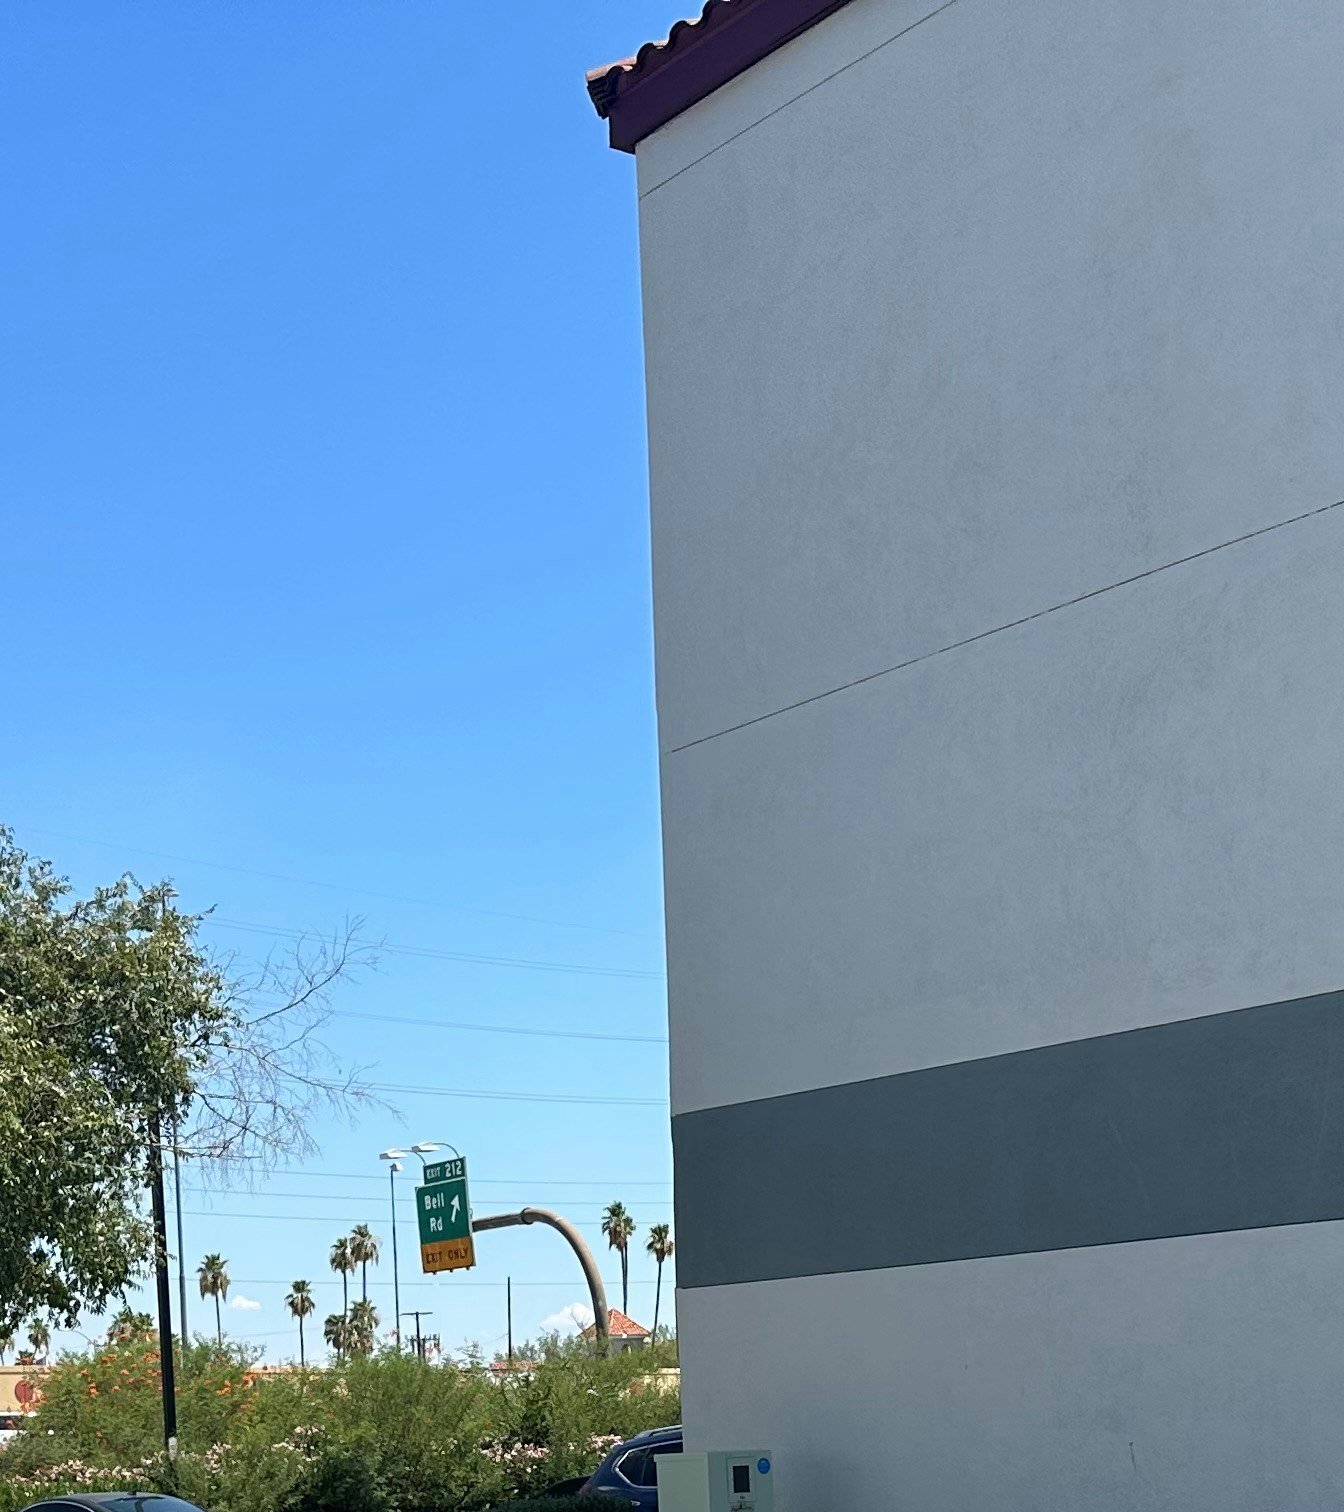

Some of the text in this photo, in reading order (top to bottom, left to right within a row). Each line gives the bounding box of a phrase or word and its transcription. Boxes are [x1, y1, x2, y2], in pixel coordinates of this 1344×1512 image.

[445, 1160, 463, 1178] 212
[424, 1192, 445, 1210] Bell
[429, 1216, 443, 1232] Rd
[425, 1247, 469, 1264] EXIT ONLY
